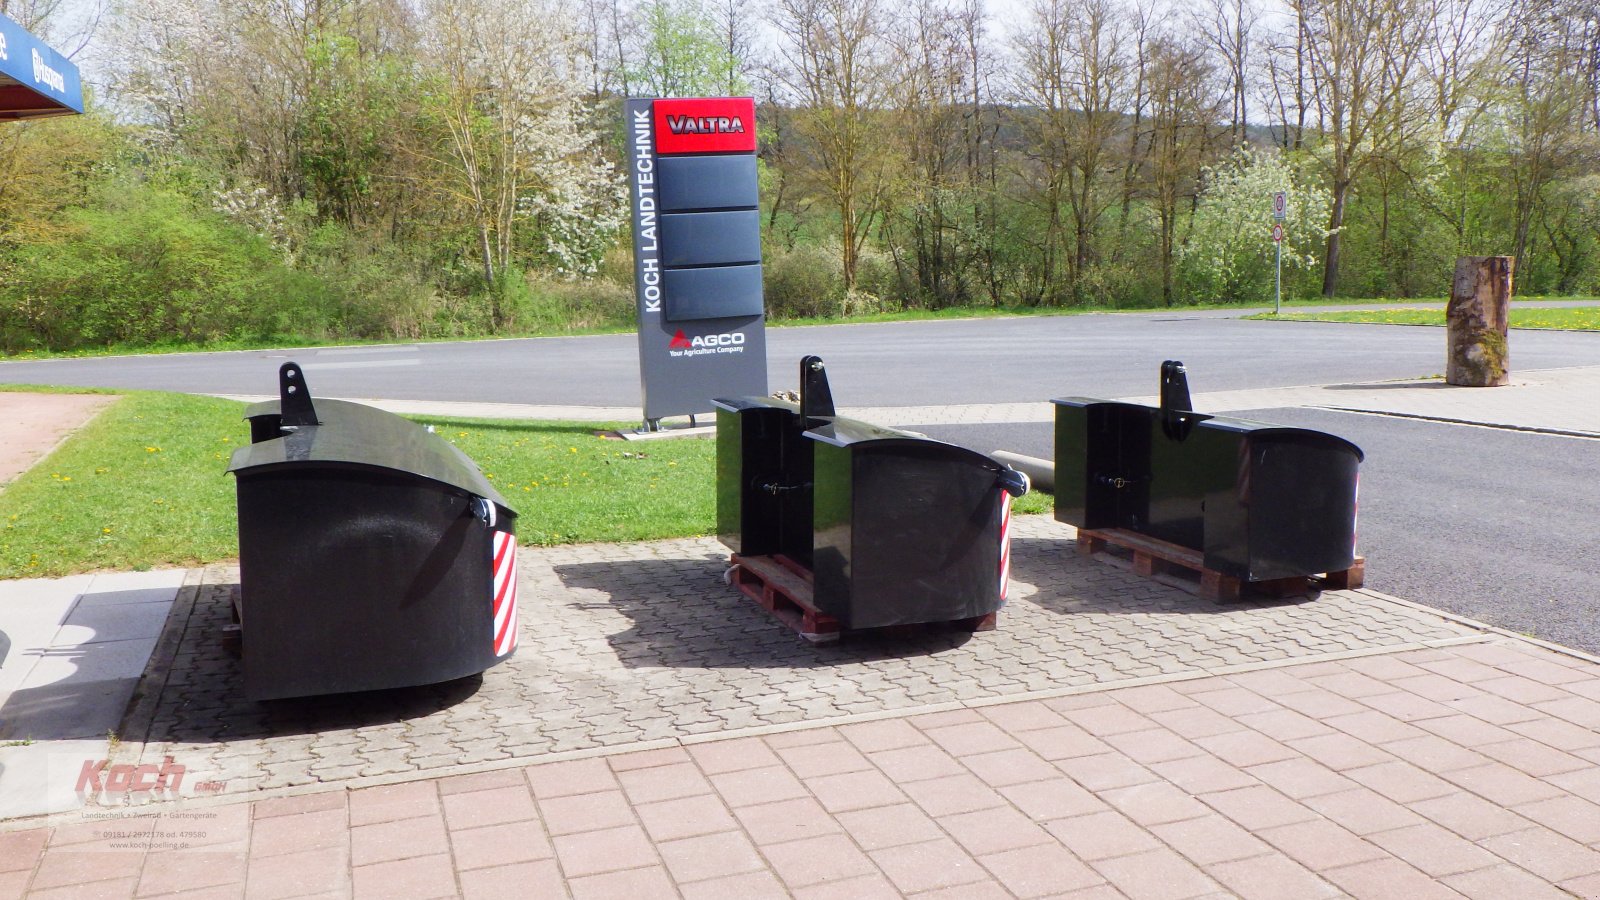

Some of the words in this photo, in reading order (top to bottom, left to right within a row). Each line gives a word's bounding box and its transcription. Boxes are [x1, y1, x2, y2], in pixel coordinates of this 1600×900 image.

[666, 115, 745, 134] VALTRA
[634, 109, 658, 251] LANDTECHNIK
[642, 258, 661, 312] KOCH
[691, 332, 745, 347] AGCO
[684, 347, 716, 357] Agriculture
[717, 345, 744, 354] Company
